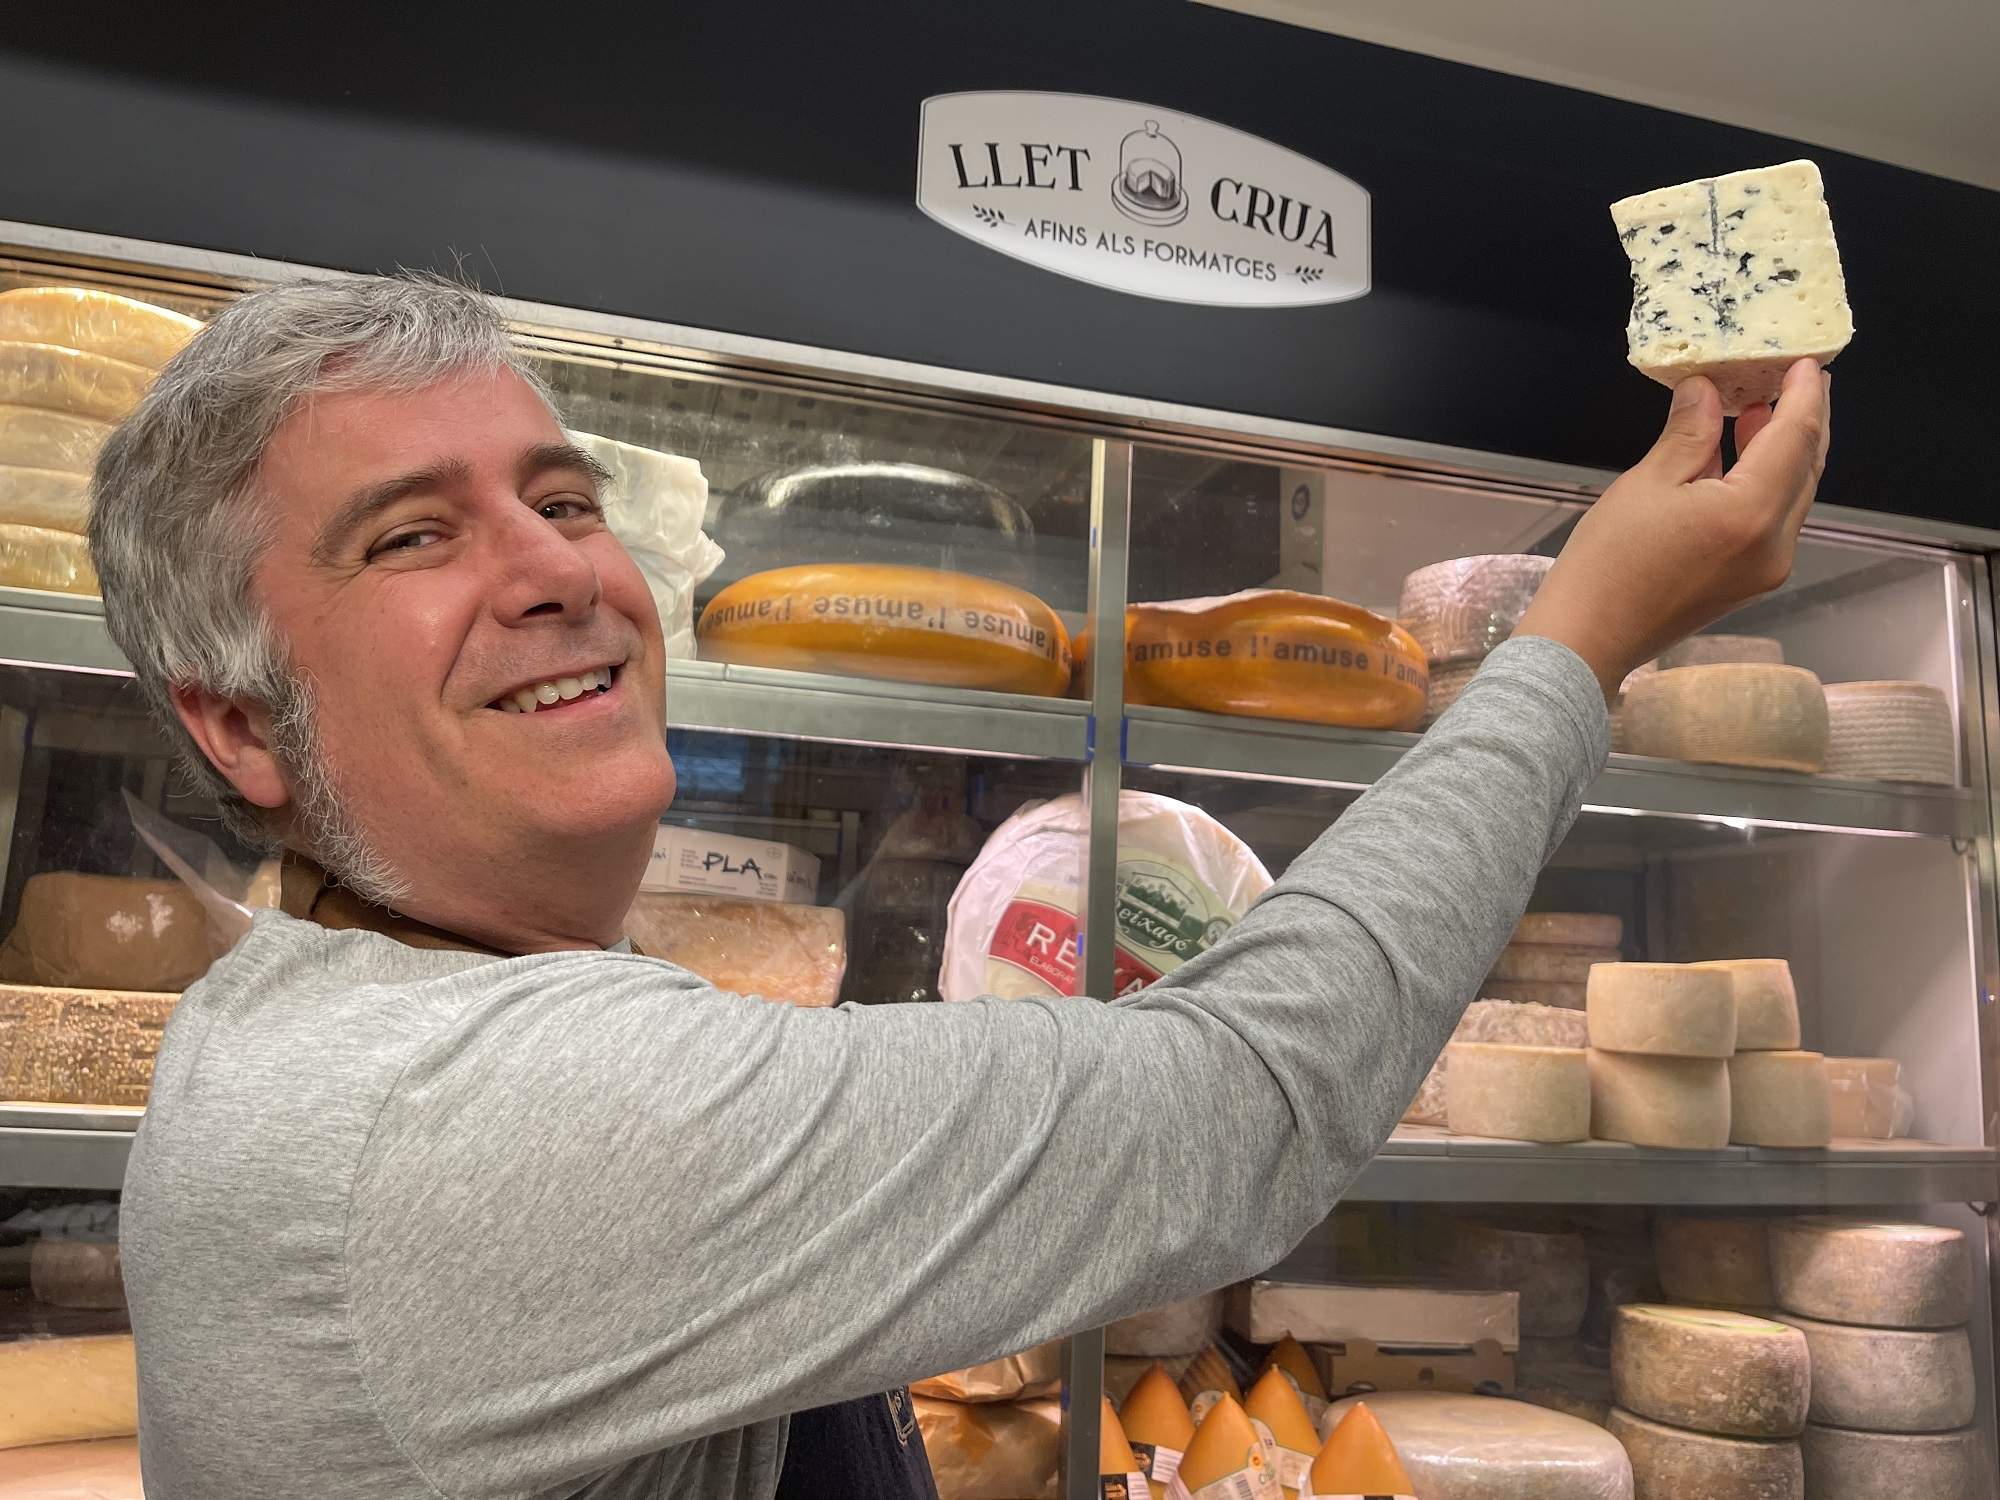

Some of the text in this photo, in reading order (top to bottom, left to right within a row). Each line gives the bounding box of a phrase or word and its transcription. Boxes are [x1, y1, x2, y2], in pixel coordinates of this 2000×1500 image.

[948, 141, 1337, 258] LLET CRUA
[1024, 217, 1277, 282] AFINS ALS FORMATGES
[814, 595, 946, 630] l'amuse
[1250, 635, 1369, 671] l'amuse
[703, 851, 762, 880] PLA
[1116, 900, 1193, 951] eixagó
